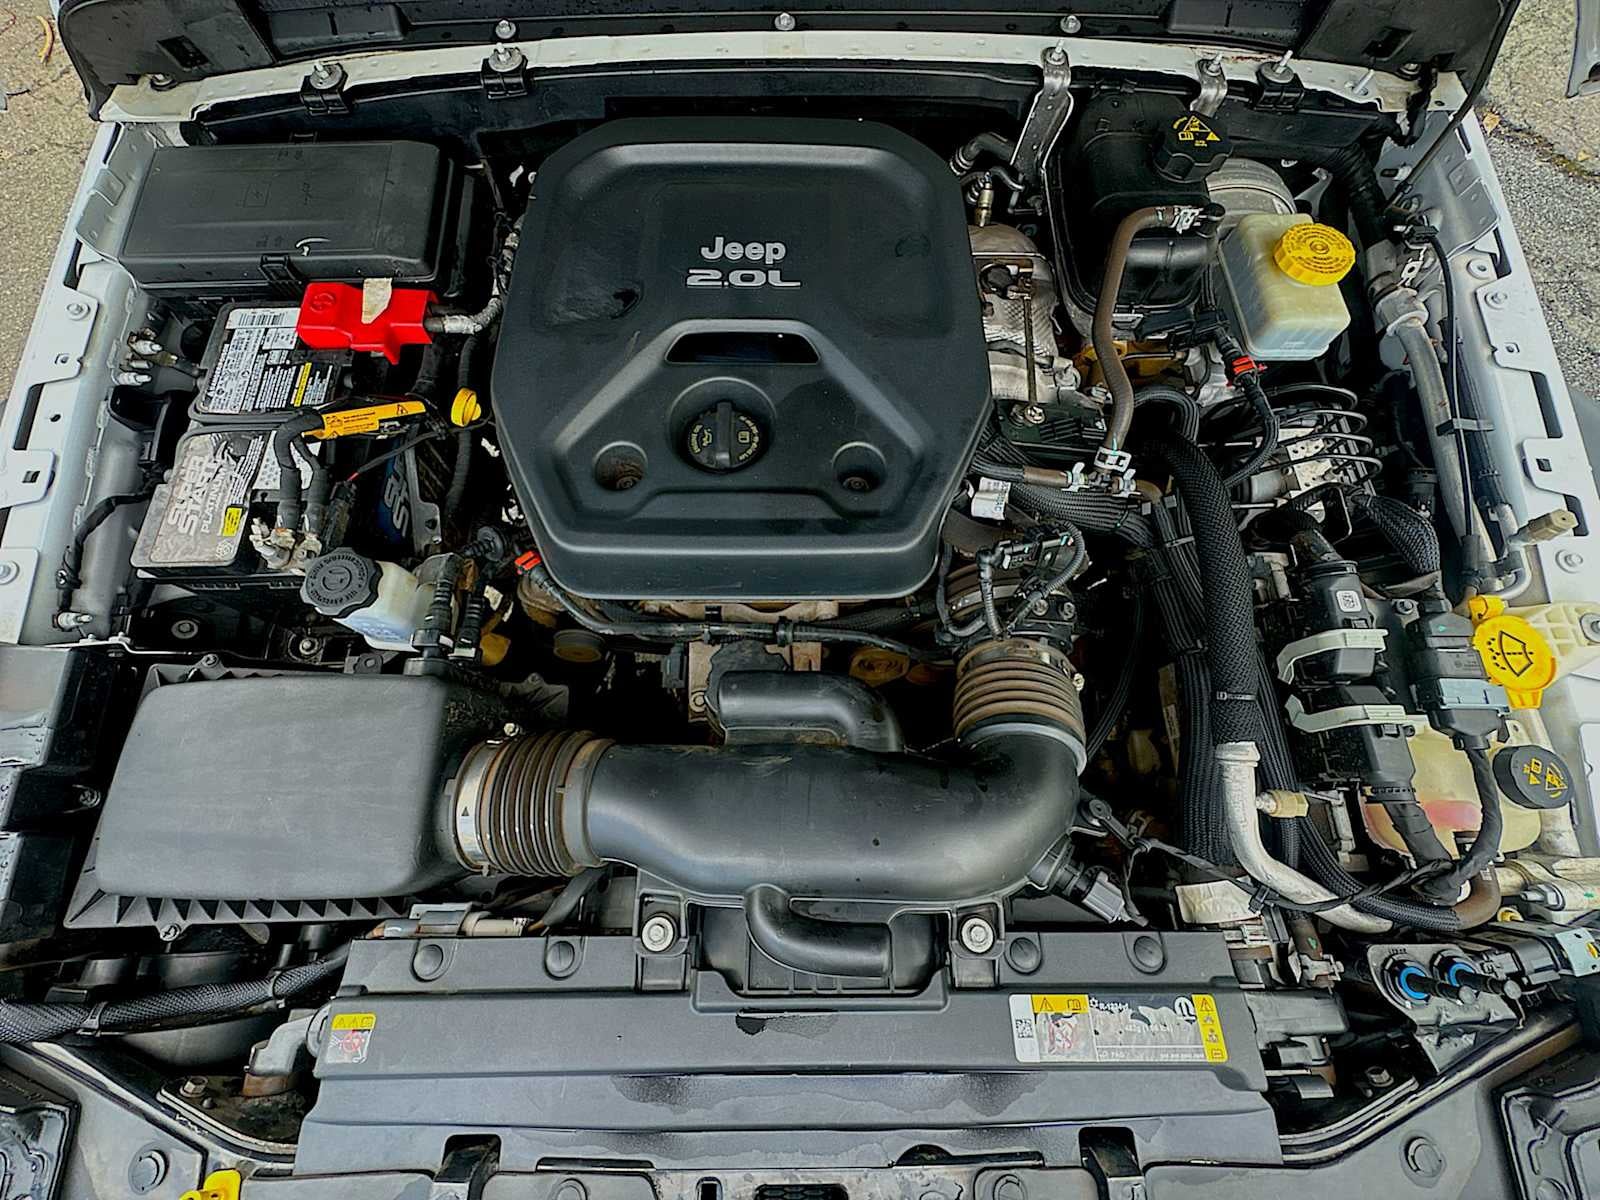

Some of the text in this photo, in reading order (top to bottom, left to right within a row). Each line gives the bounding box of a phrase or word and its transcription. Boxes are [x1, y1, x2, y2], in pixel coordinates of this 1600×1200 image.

[687, 269, 801, 287] 2.0L
[701, 237, 786, 264] Jeep
[167, 455, 206, 525] SUPER
[178, 462, 218, 536] START
[200, 466, 229, 534] PLATINUM
